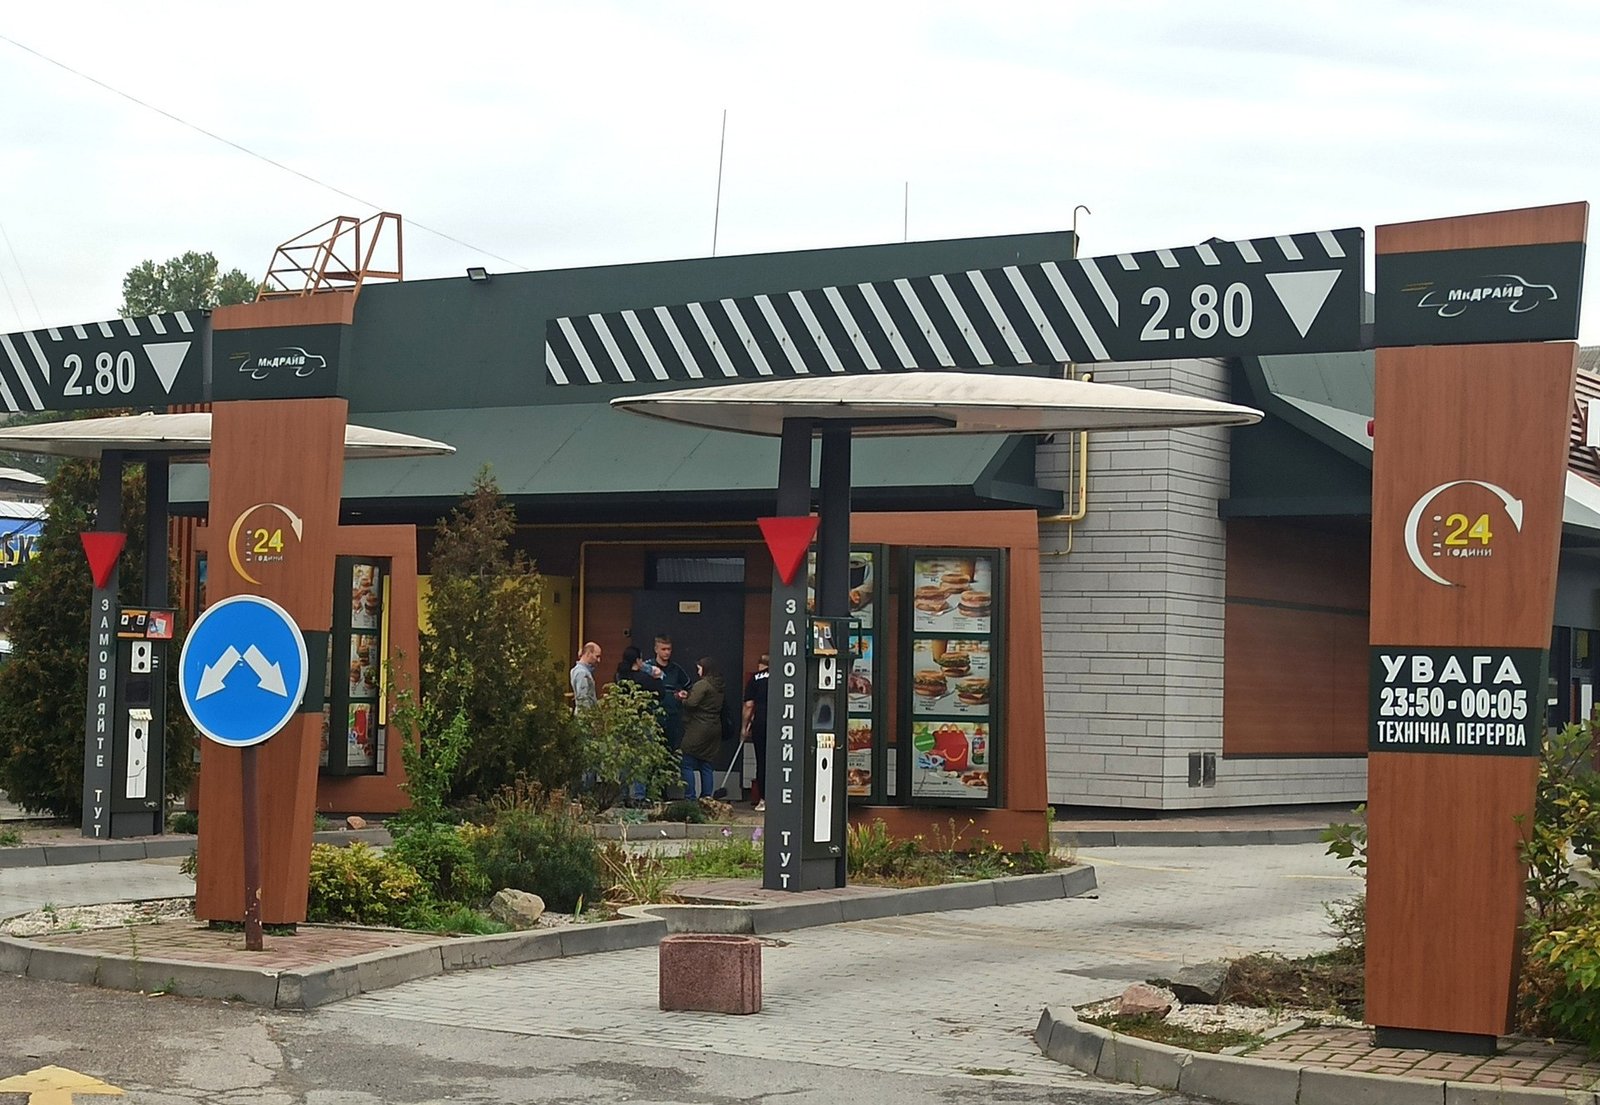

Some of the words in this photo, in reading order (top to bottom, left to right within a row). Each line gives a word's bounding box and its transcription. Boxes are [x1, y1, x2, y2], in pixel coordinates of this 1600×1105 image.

[1140, 282, 1252, 341] 2.80
[62, 351, 136, 397] 2.80
[253, 528, 284, 552] 24
[1445, 514, 1492, 545] 24
[95, 599, 109, 768] ЗАМОВЛЯЙТЕ
[1380, 655, 1522, 684] УВАГА
[781, 598, 798, 804] ЗАМОВЛЯЙТЕ
[1377, 721, 1450, 744] ТЕХНІЧНА
[1456, 723, 1526, 746] ПЕРЕРВА
[93, 790, 103, 837] ТУТ
[780, 831, 791, 889] ТУТ
